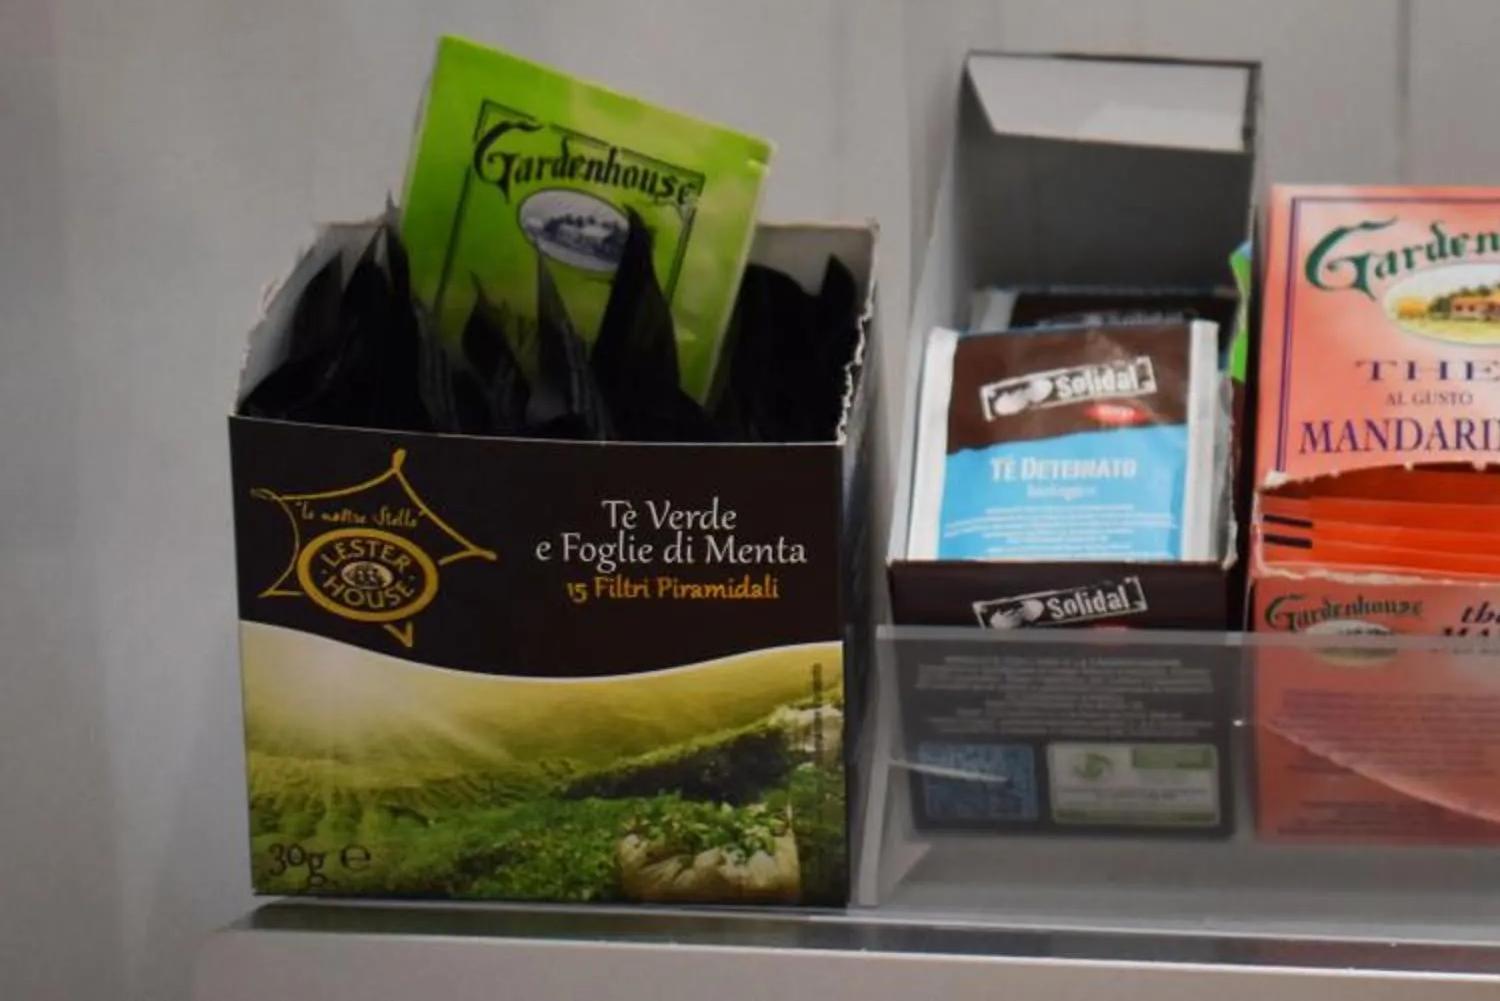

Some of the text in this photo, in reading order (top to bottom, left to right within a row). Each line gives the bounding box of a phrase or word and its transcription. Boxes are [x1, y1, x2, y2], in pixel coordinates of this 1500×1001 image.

[473, 120, 699, 205] Gardenhouse
[1056, 363, 1139, 399] Solidal
[1386, 391, 1474, 406] AL GUSTO
[602, 497, 737, 530] Tè Verde
[321, 538, 412, 573] LESTER
[535, 530, 808, 574] e Foglie di Menta
[323, 575, 416, 609] HOUSE
[566, 573, 780, 604] 15 Filtri Piramidali
[1047, 585, 1130, 620] Solidal
[1264, 592, 1424, 633] Gardenhouse
[267, 843, 327, 889] 30g
